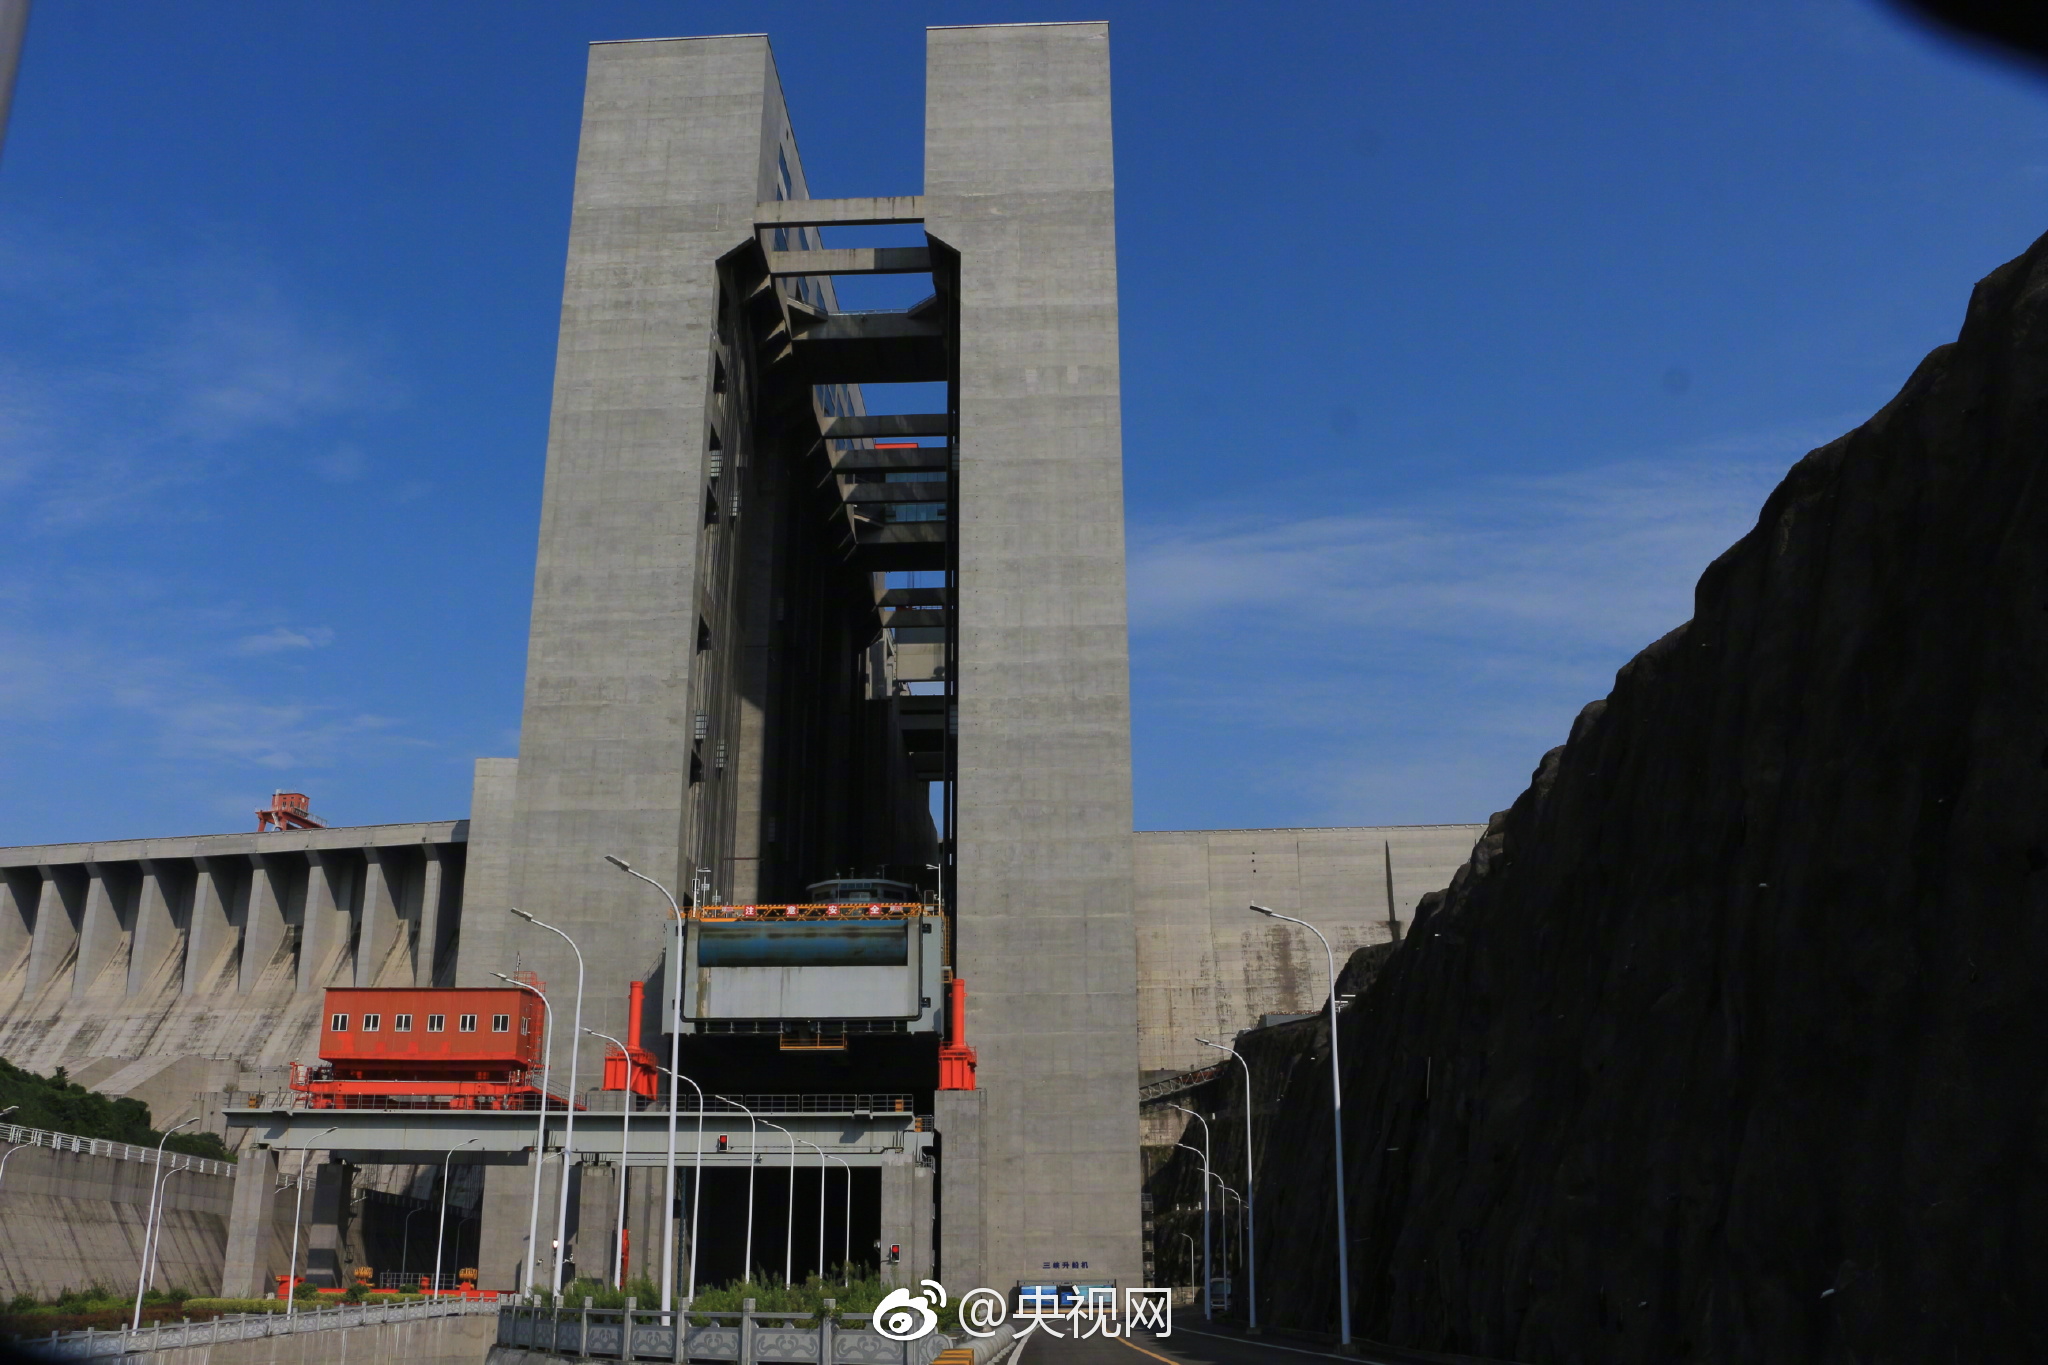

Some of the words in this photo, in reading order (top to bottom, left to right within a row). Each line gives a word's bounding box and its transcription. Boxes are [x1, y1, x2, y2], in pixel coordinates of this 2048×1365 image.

[745, 904, 880, 915] 注意安全
[1042, 1261, 1089, 1269] 三峡升船机
